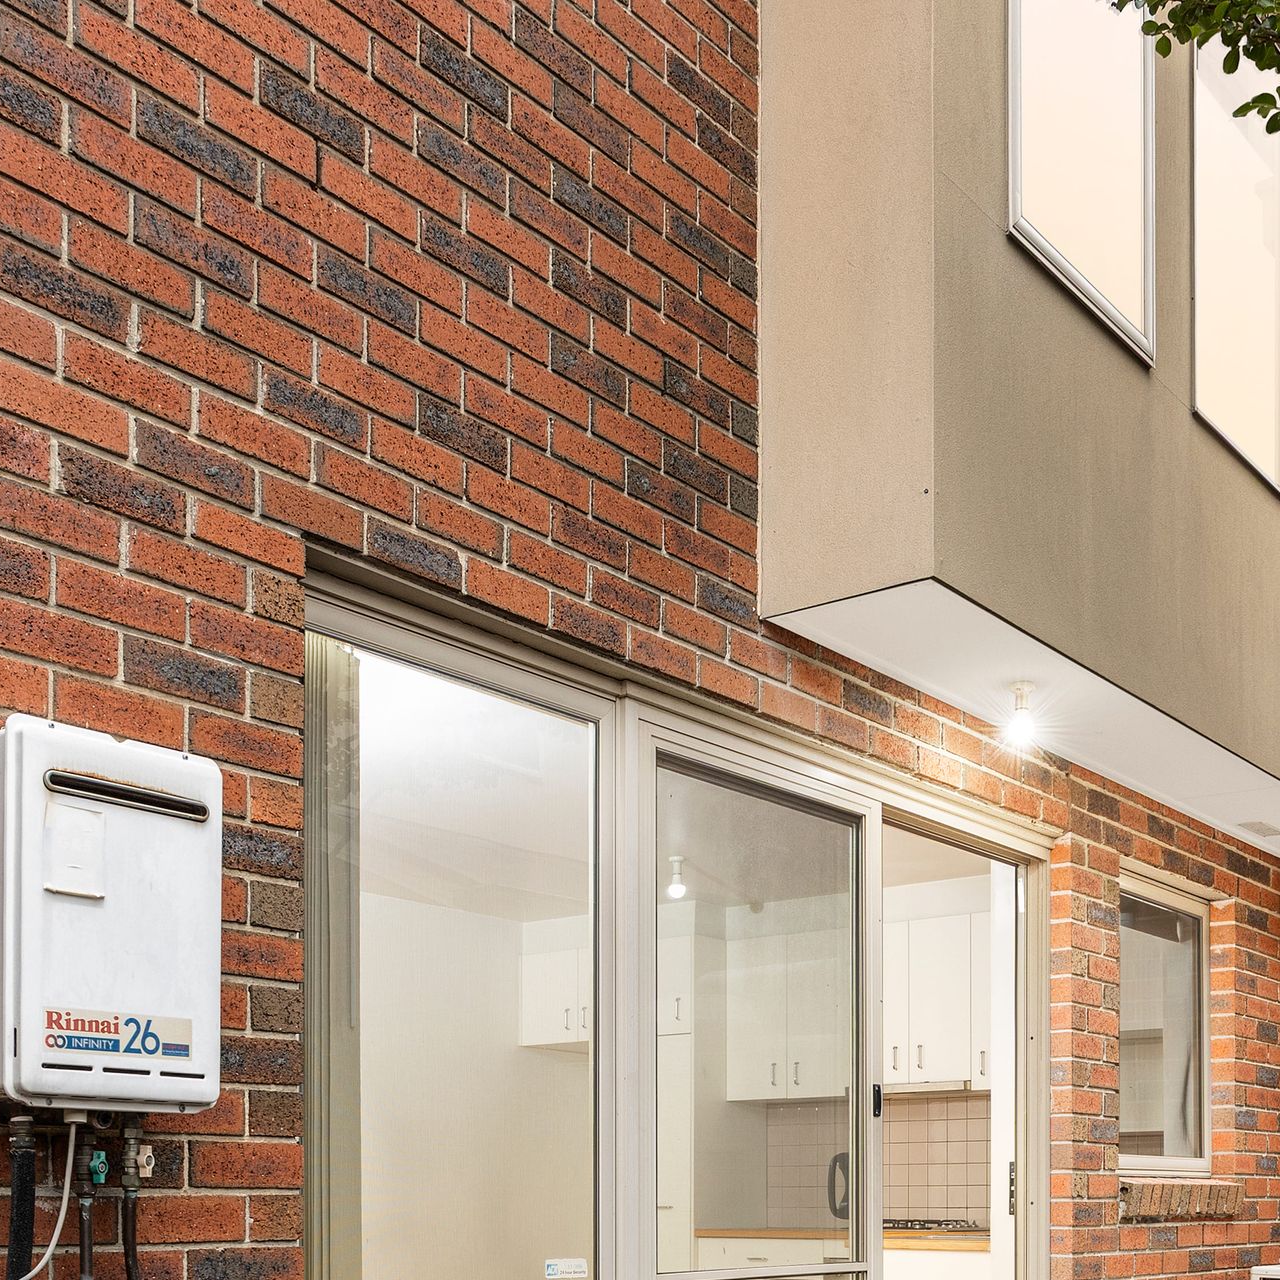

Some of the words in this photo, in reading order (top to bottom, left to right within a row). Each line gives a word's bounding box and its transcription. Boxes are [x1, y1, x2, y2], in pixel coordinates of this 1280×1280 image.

[45, 1010, 120, 1035] Rinnai
[71, 1037, 115, 1050] INFINITY
[122, 1017, 160, 1055] 26
